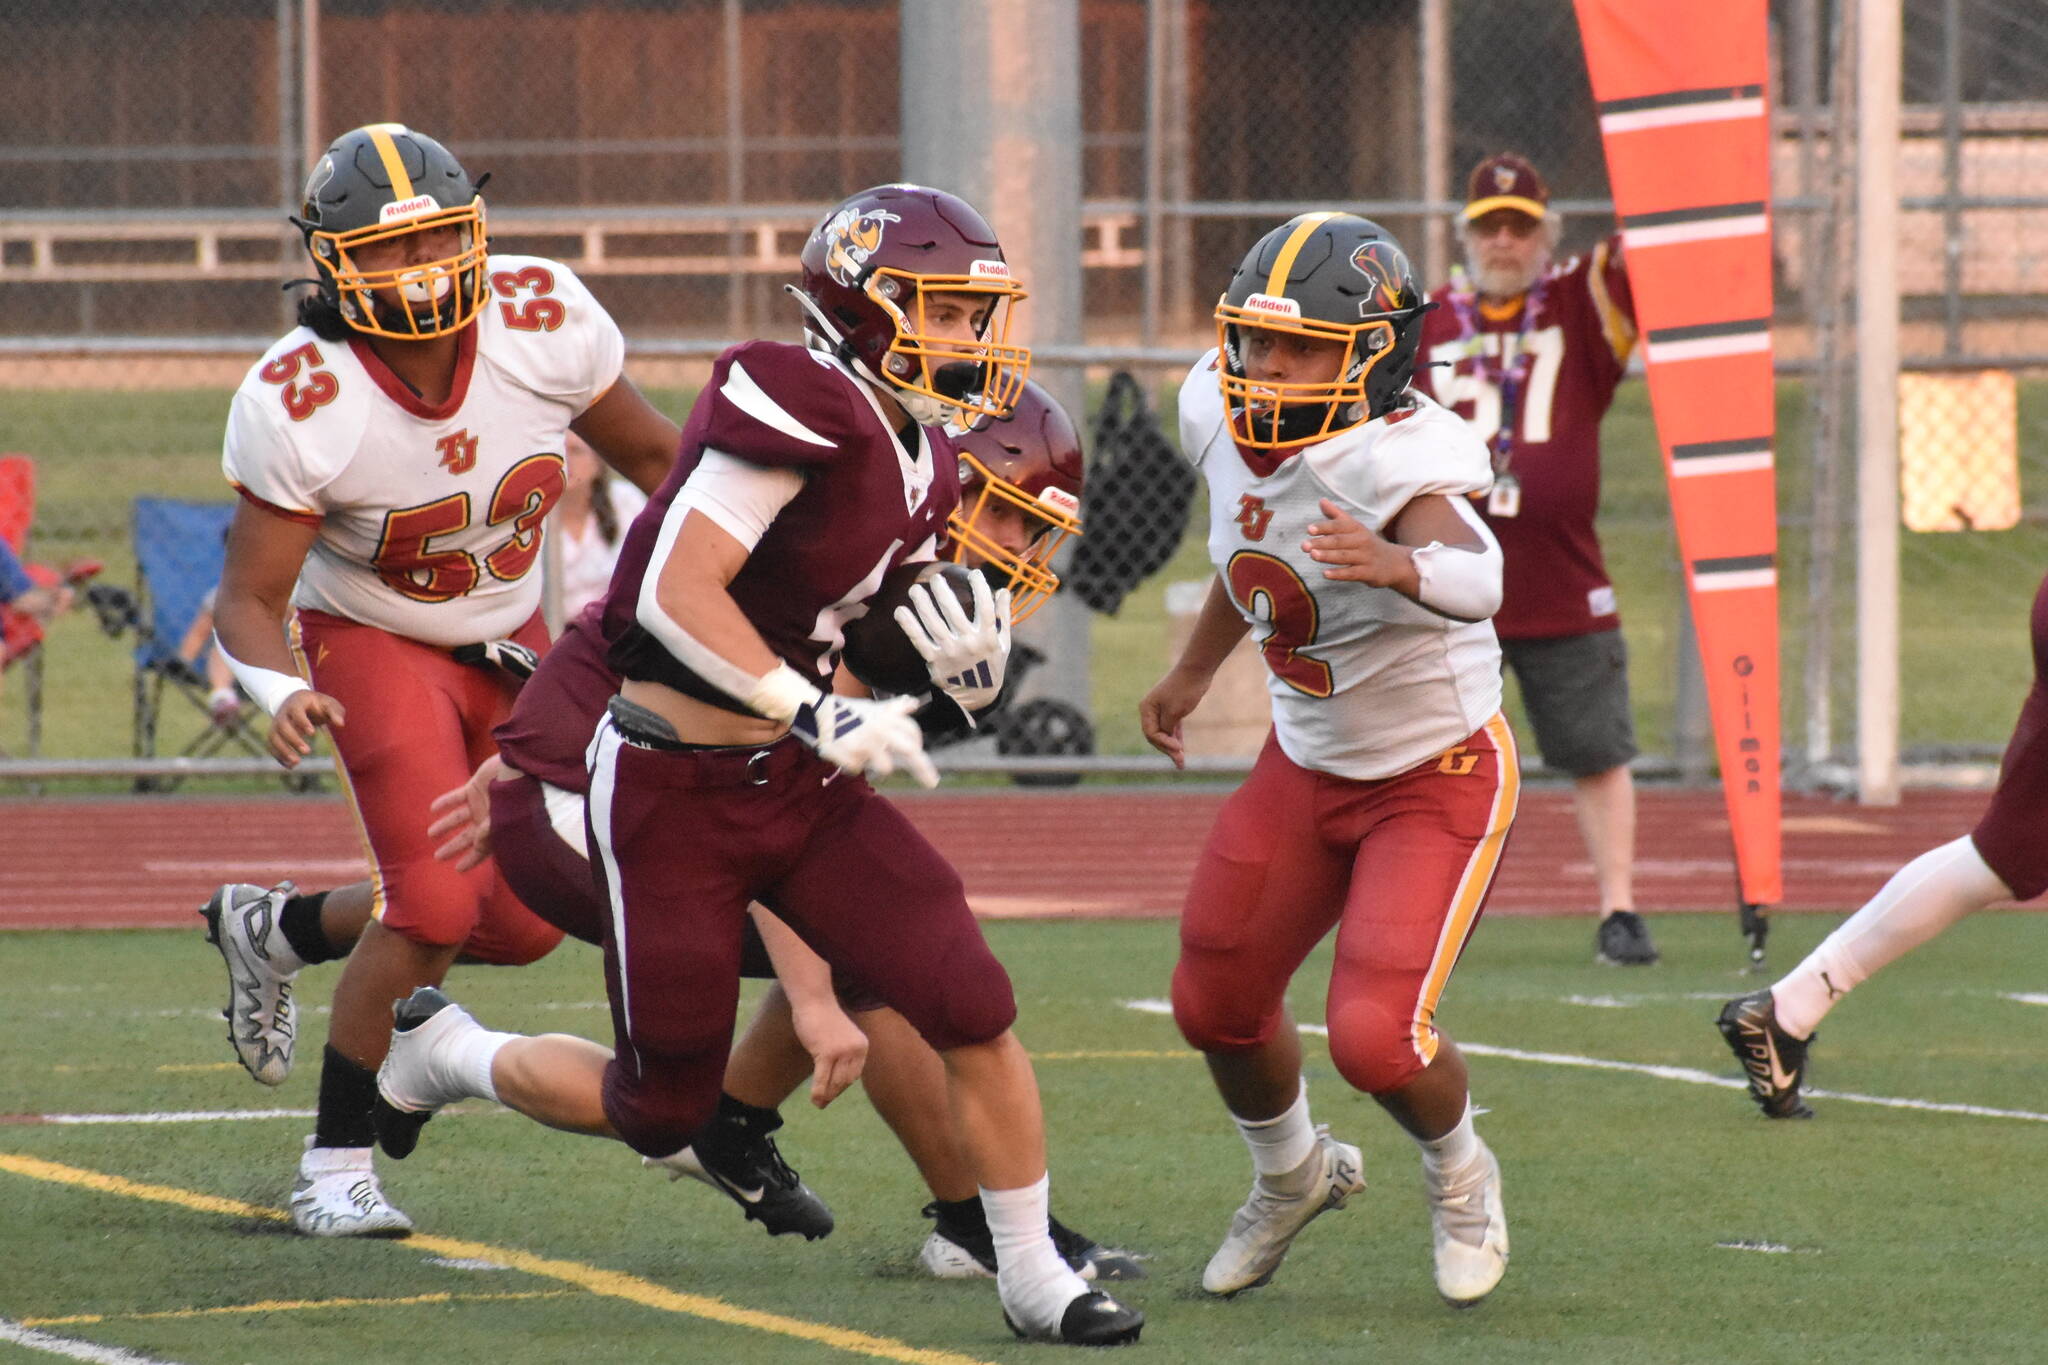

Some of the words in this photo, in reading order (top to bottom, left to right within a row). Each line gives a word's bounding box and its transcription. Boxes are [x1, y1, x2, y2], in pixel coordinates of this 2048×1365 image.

[386, 197, 430, 216] Riddell
[490, 265, 566, 333] 53
[1248, 297, 1292, 313] Riddell
[259, 340, 340, 422] 53
[1429, 325, 1566, 443] 57
[370, 452, 567, 604] 53
[1227, 548, 1335, 699] 2
[1732, 654, 1761, 794] Gilman
[1736, 1000, 1773, 1097] VAPOR
